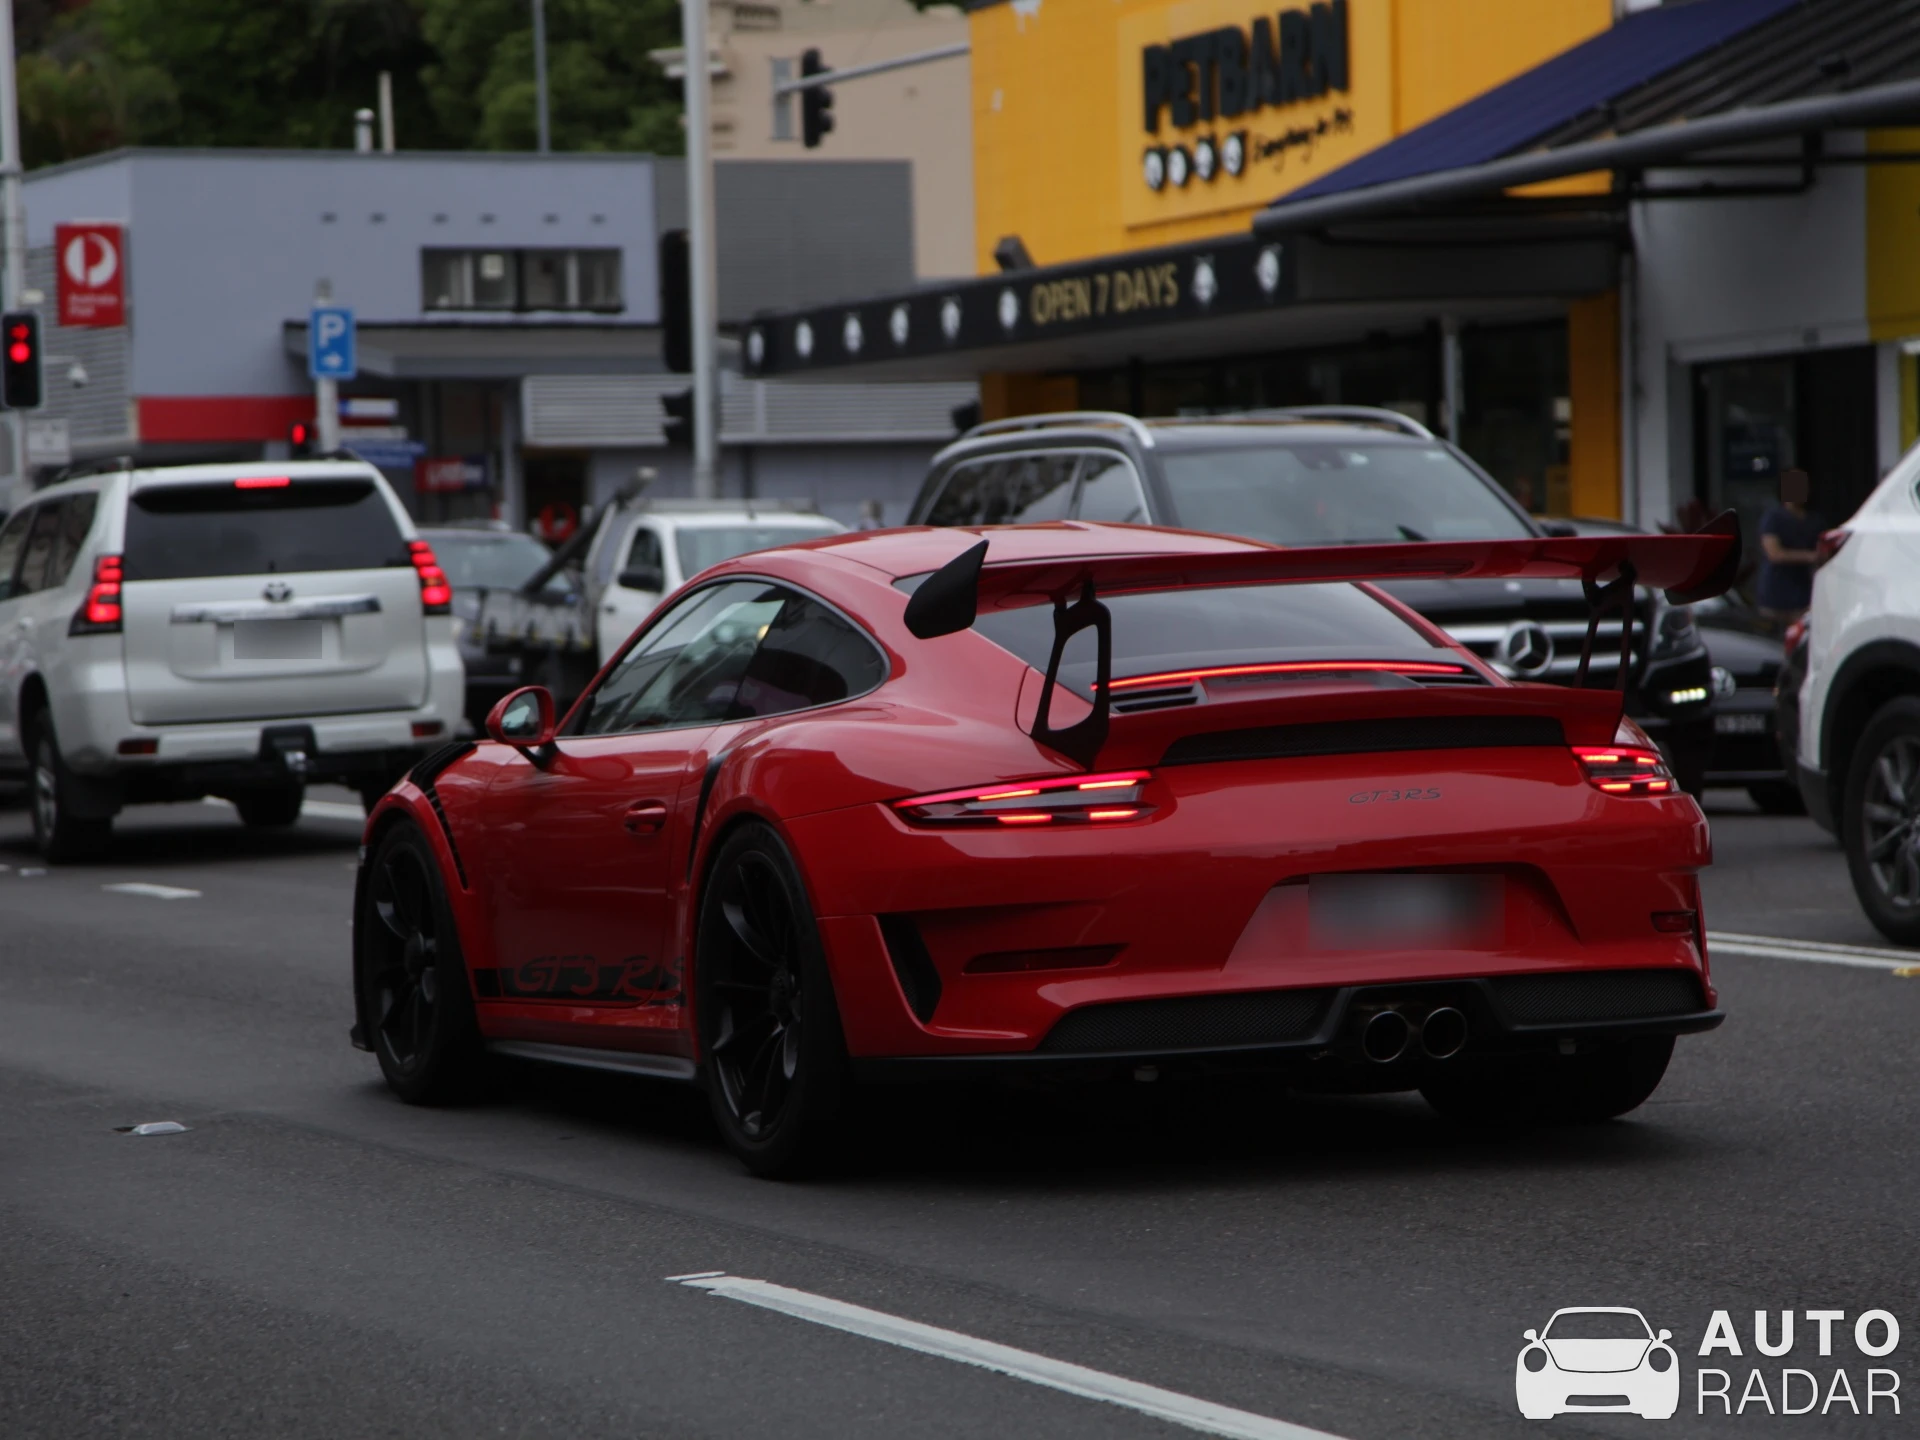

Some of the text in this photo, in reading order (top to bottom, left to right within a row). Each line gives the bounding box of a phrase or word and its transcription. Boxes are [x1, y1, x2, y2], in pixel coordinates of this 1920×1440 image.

[1142, 0, 1350, 135] PETBARN
[1030, 263, 1179, 327] OPEN 7 DAYS
[317, 313, 346, 348] P
